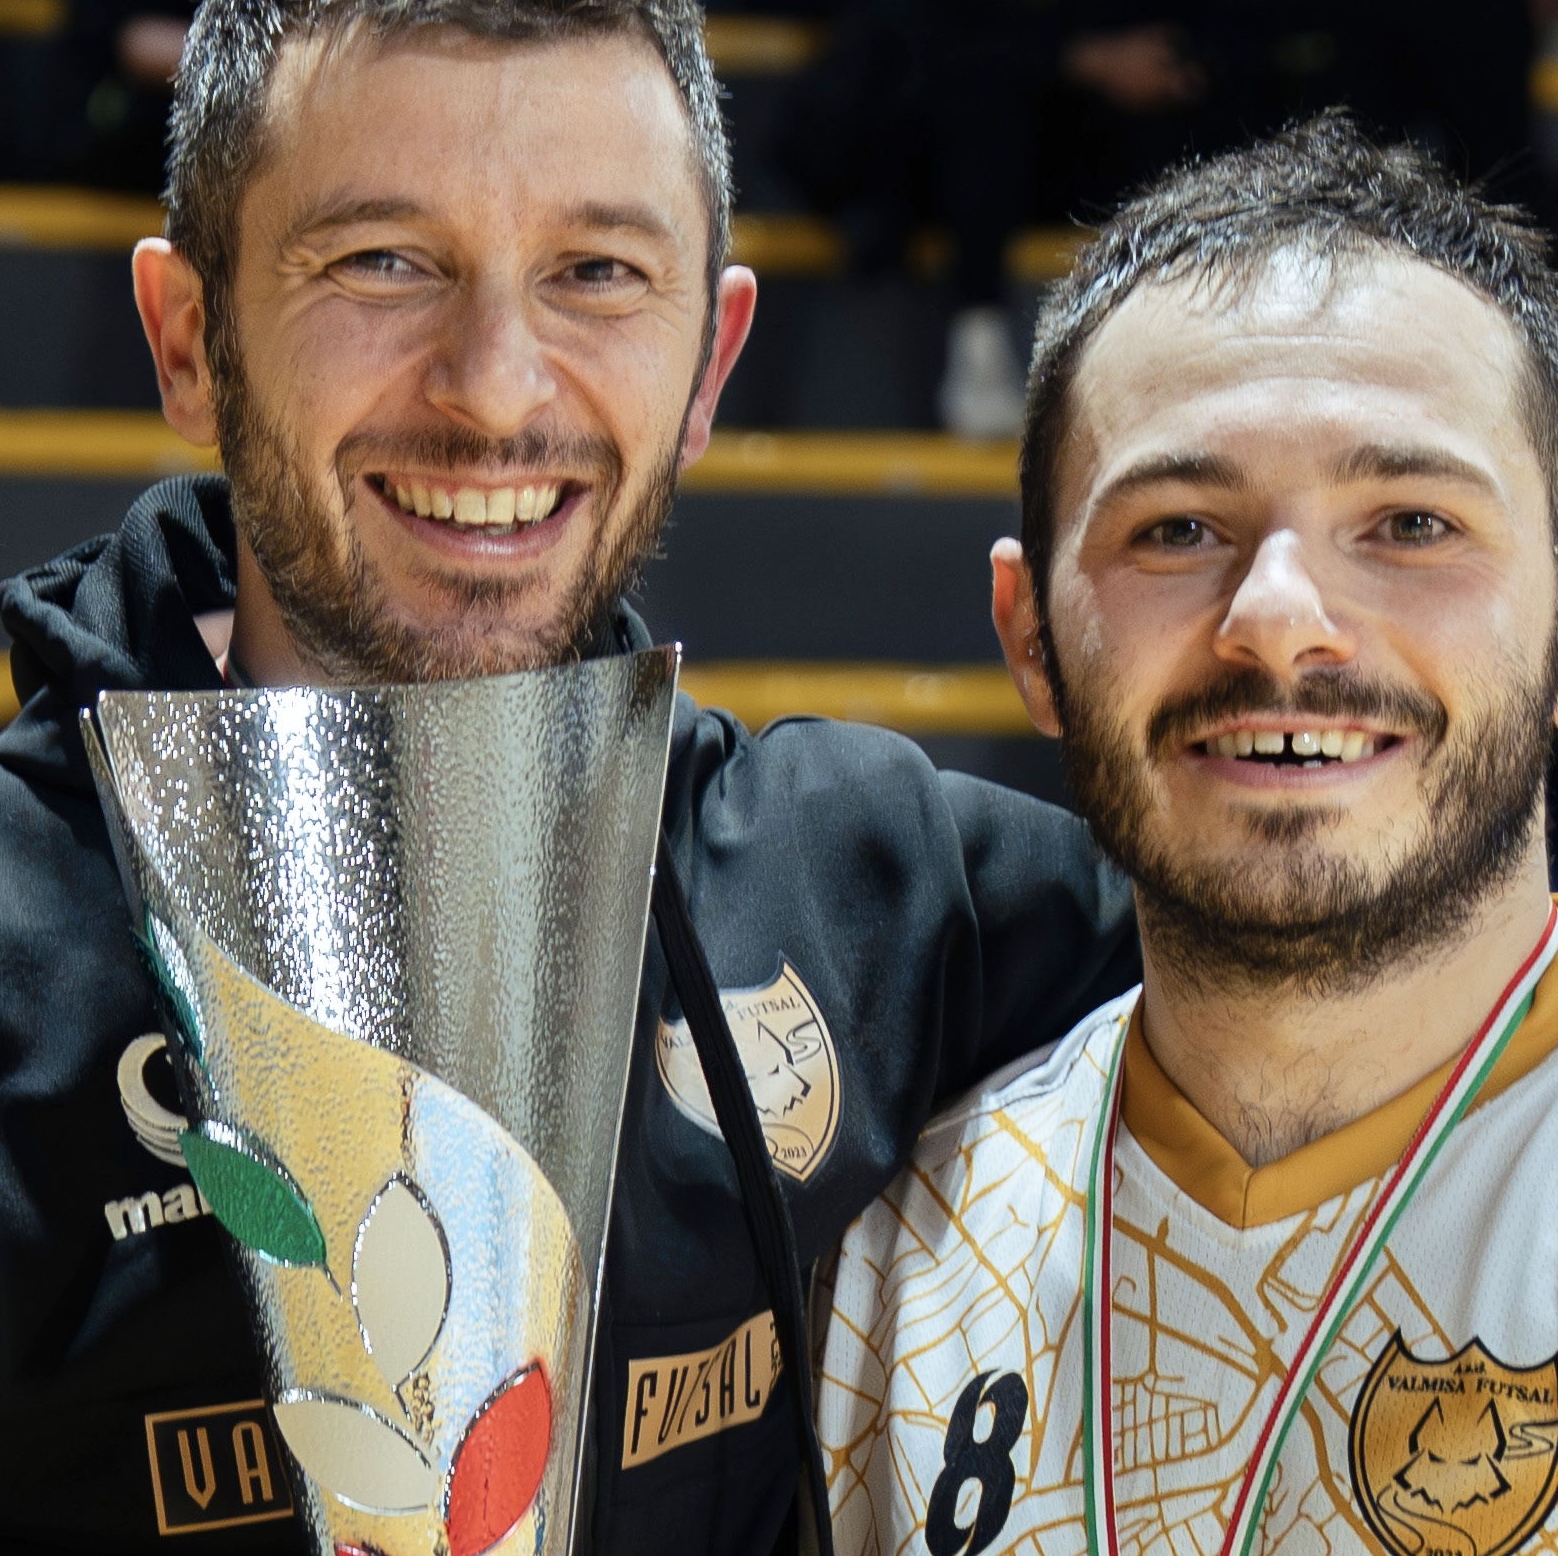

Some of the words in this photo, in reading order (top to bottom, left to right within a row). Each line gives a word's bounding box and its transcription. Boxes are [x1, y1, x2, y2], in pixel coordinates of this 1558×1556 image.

[737, 995, 801, 1021] FUTSAL
[780, 1145, 808, 1160] 2023
[1388, 1373, 1466, 1395] VALMISA
[1475, 1376, 1554, 1405] FUTSAL
